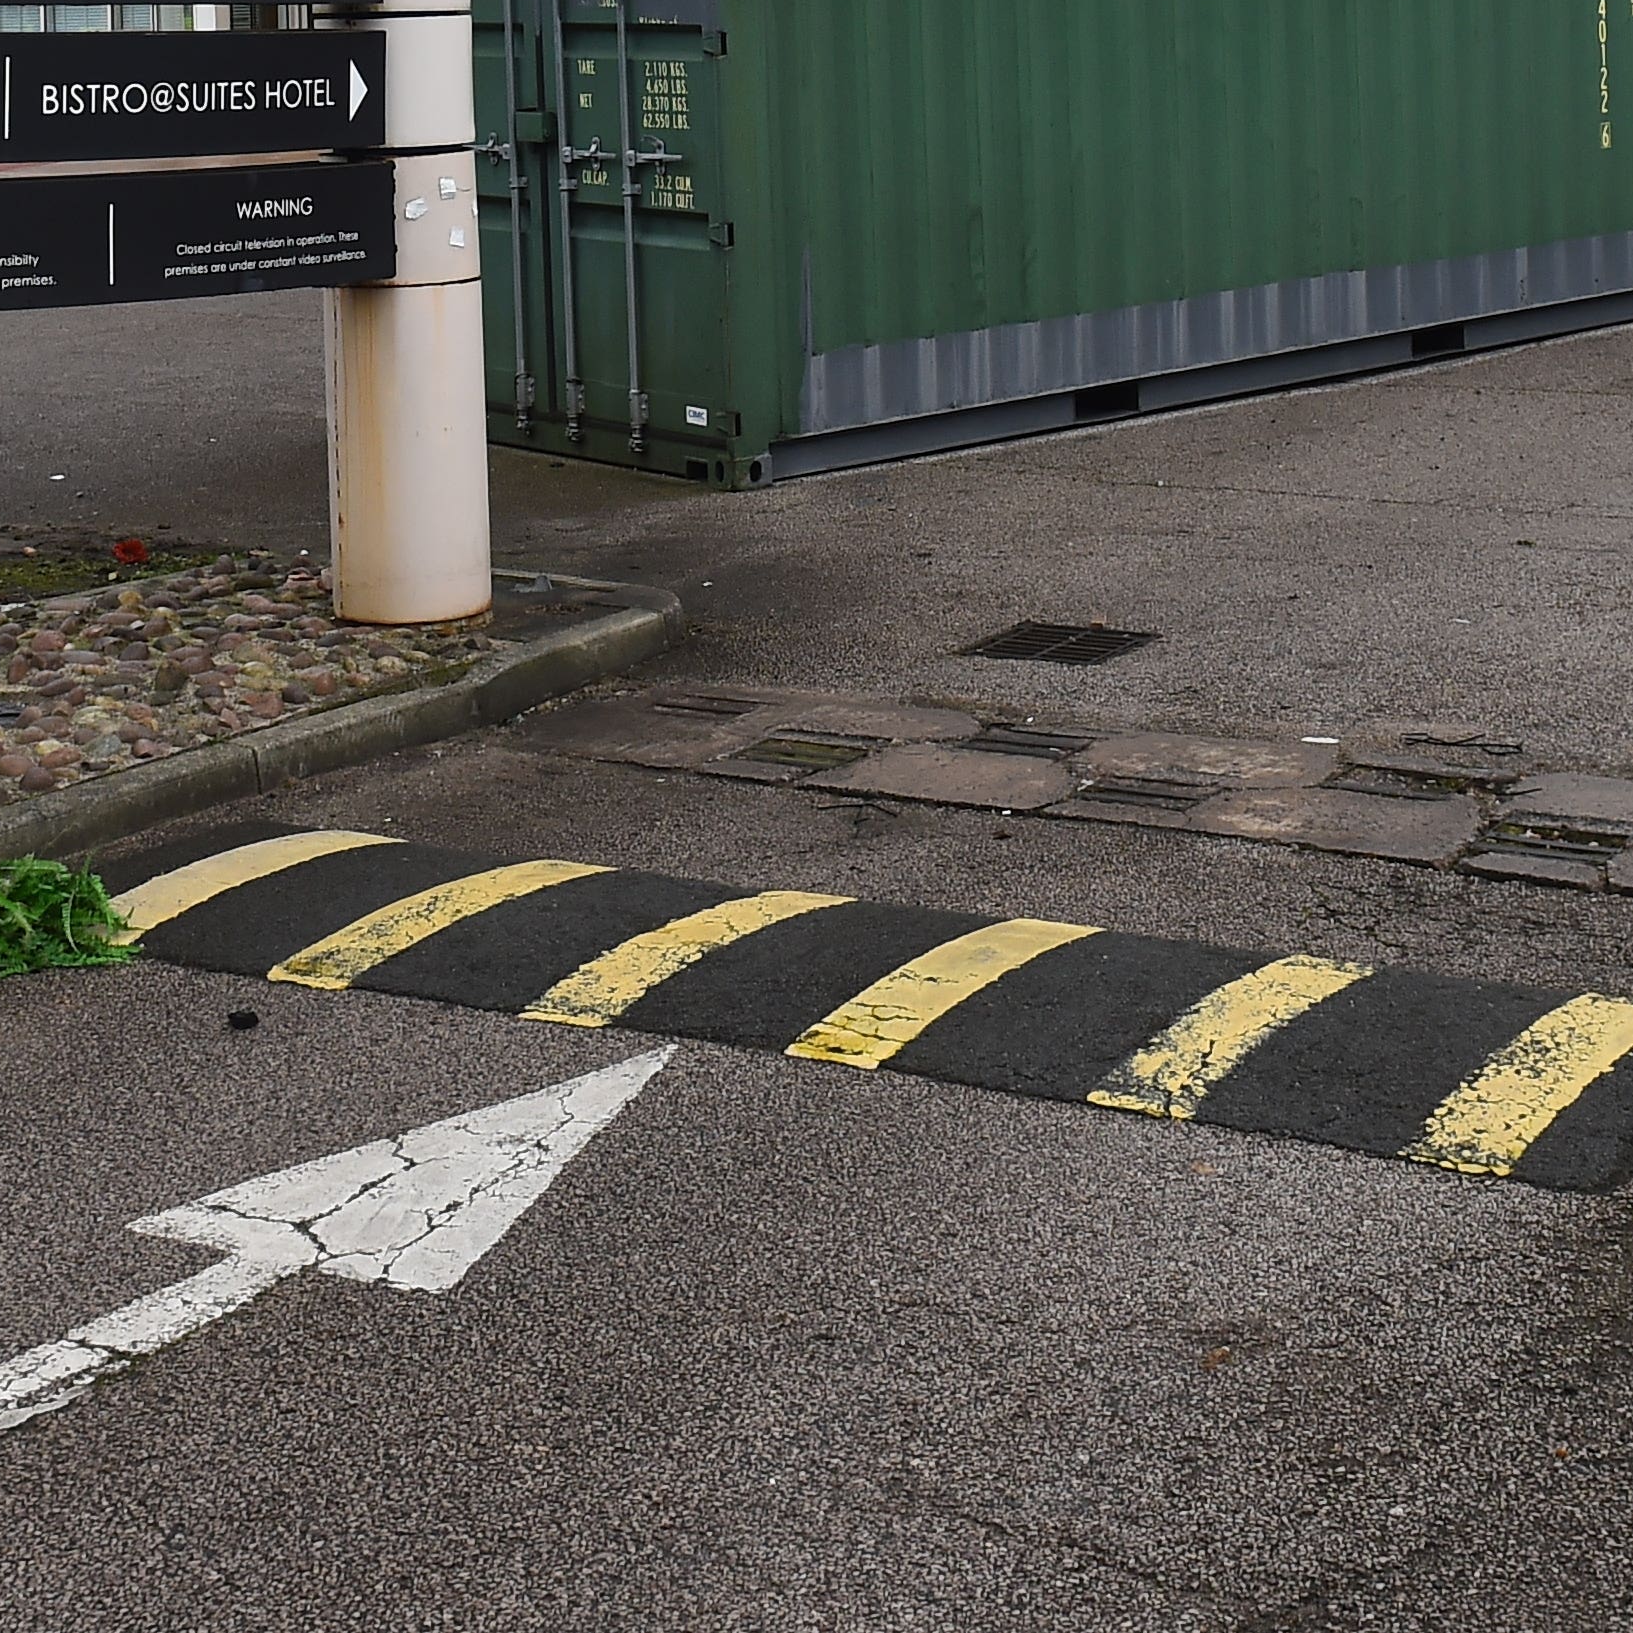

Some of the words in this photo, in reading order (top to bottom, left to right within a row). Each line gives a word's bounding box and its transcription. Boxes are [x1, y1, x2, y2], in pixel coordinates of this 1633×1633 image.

[577, 60, 596, 75] TARE
[645, 61, 668, 77] 2.110
[42, 80, 256, 114] BISTRO@SUITES
[266, 78, 335, 108] HOTEL
[646, 79, 669, 94] 4.650
[579, 93, 593, 108] NET
[1601, 123, 1611, 149] 6
[236, 197, 313, 219] WARNING
[176, 242, 211, 256] Closed
[213, 240, 243, 253] circuit
[245, 237, 285, 250] television
[286, 235, 294, 246] in
[296, 232, 336, 247] operation.
[338, 231, 359, 242] These
[164, 262, 208, 279] premises
[211, 262, 227, 273] are
[229, 260, 256, 272] under
[258, 255, 297, 269] constant
[298, 253, 321, 265] video
[1, 274, 57, 290] premises.
